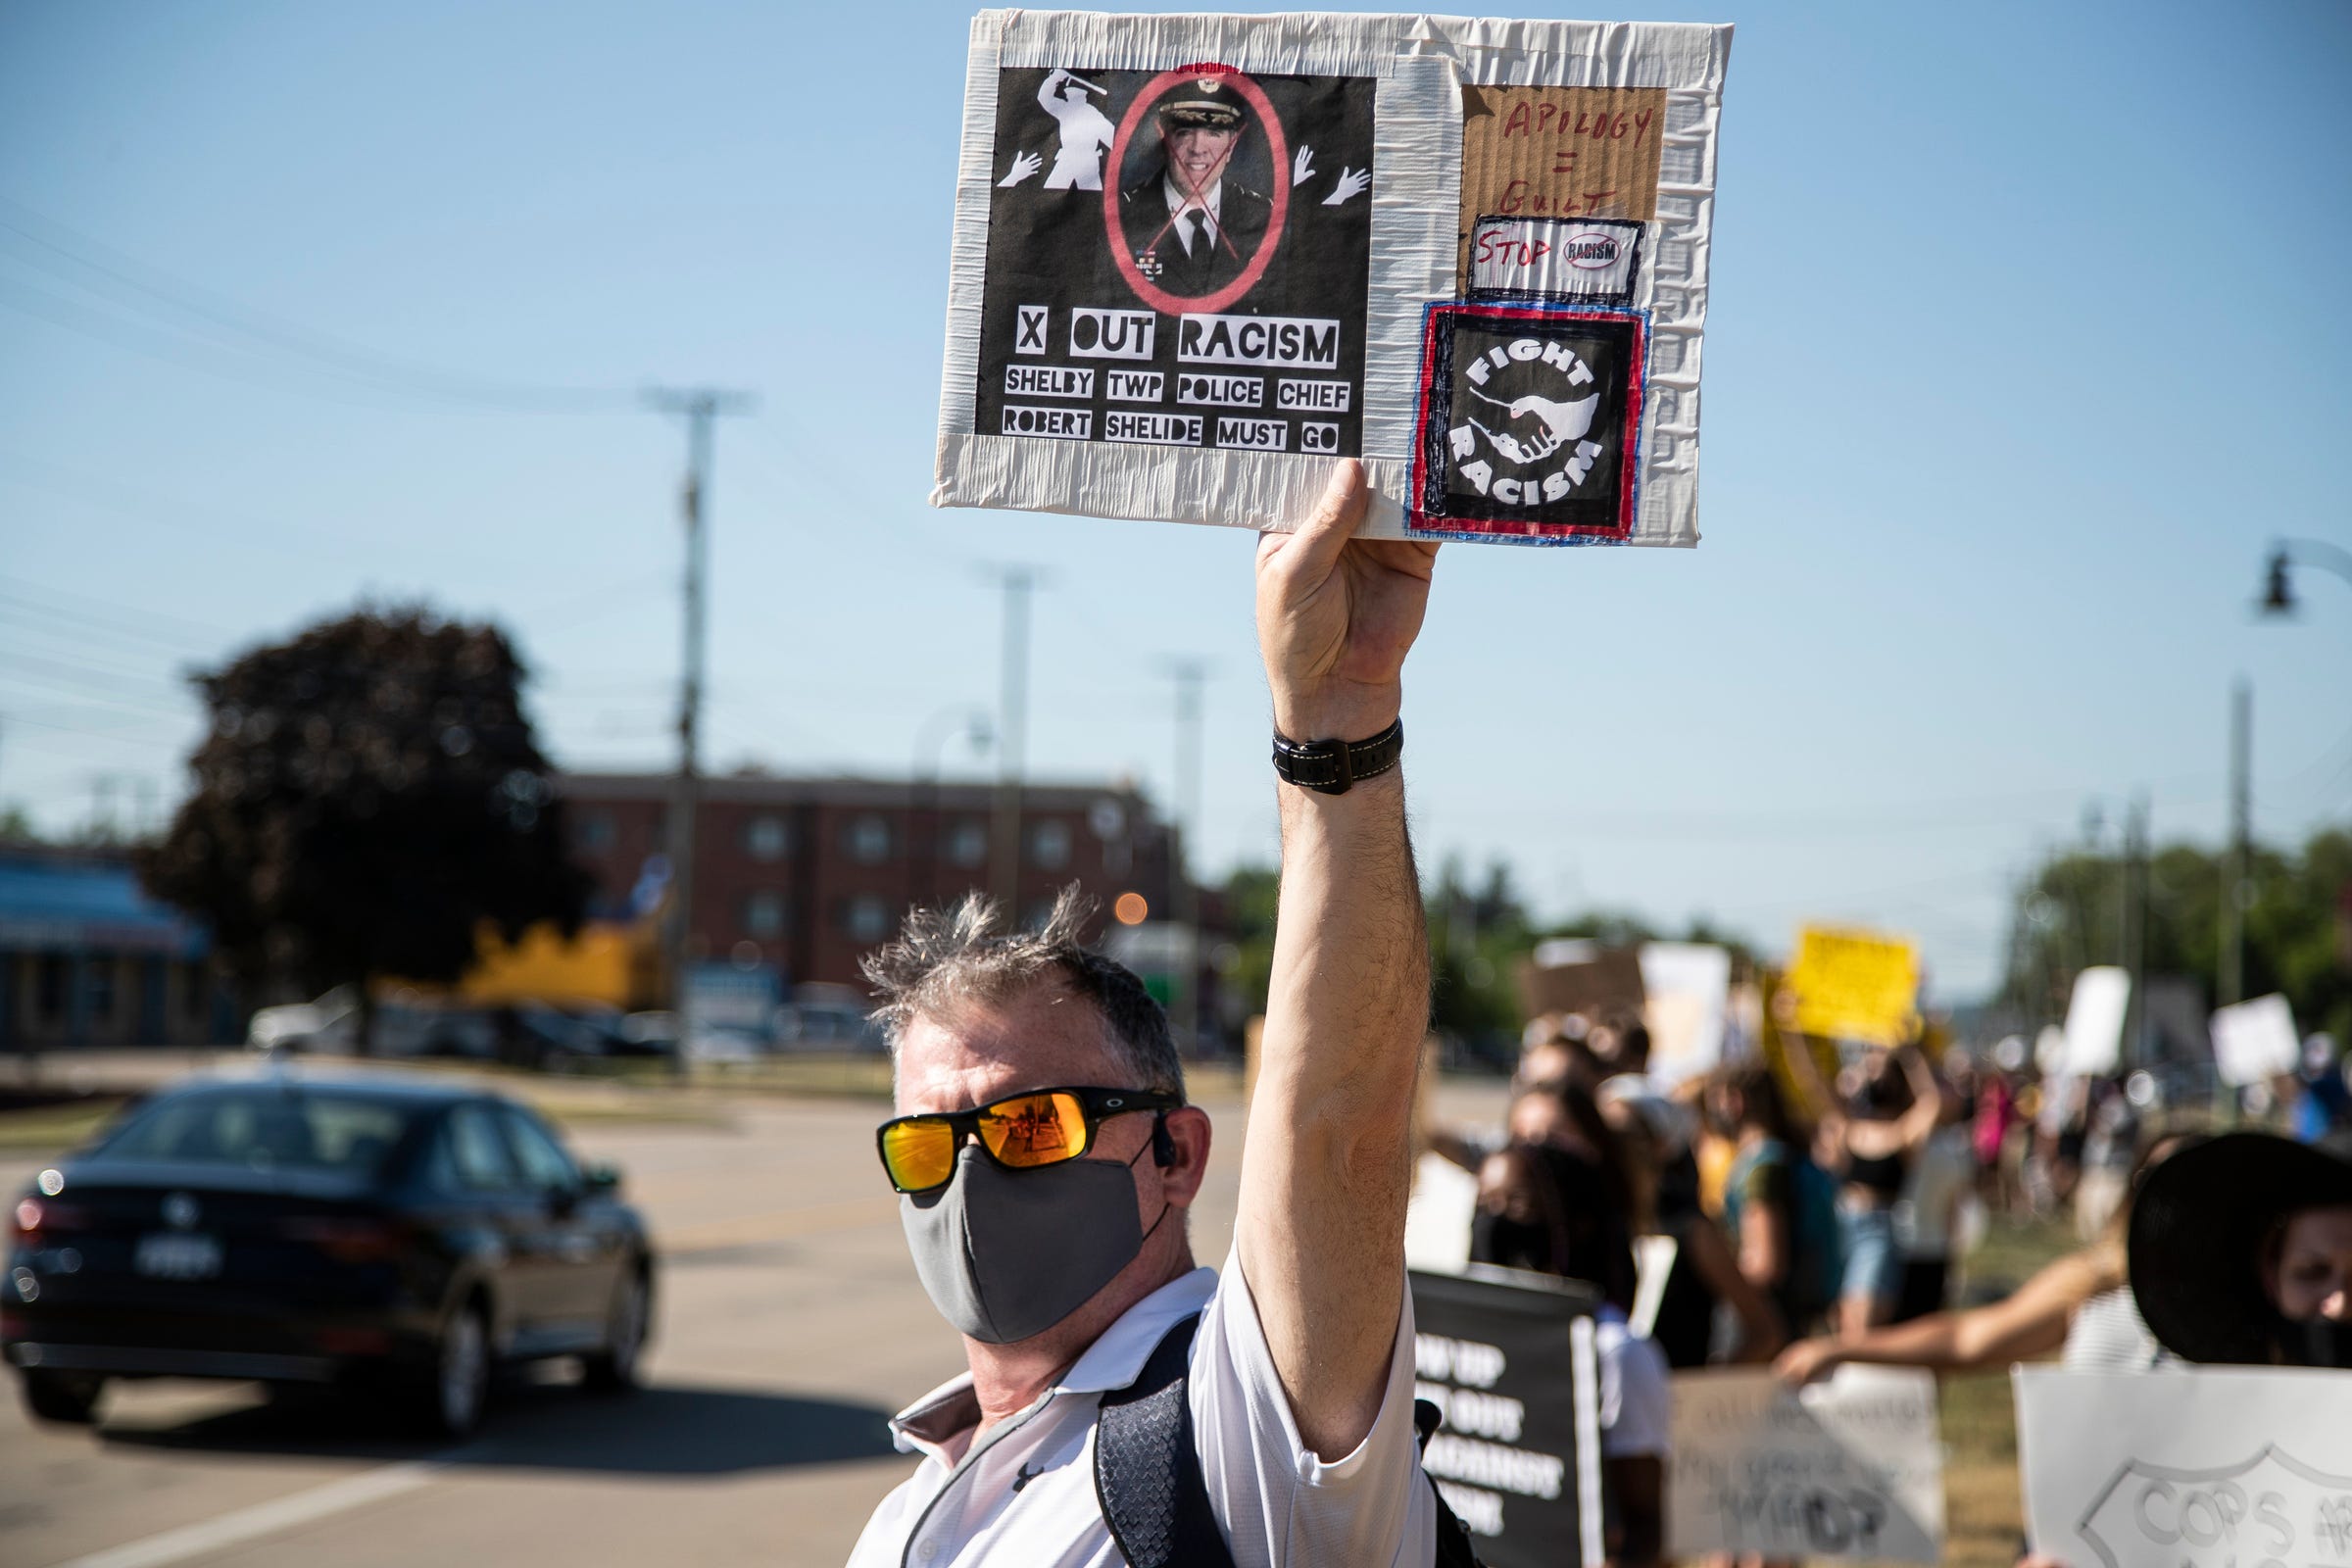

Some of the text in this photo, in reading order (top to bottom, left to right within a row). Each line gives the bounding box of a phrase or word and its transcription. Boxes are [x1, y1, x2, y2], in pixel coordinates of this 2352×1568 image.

[1503, 101, 1653, 148] APOLOGY
[1499, 179, 1618, 217] GUILT
[1478, 230, 1551, 267] STOP
[1568, 243, 1615, 260] RACISM
[1020, 311, 1337, 365] X OUT RACISM
[1466, 338, 1594, 390] FIGHT
[1006, 368, 1349, 409] SHELBY TWP POLICE CHIEF
[1004, 410, 1338, 450] ROBERT SHELIDE MUST GO
[1448, 423, 1603, 507] RACISM
[2133, 1481, 2296, 1557] COPS
